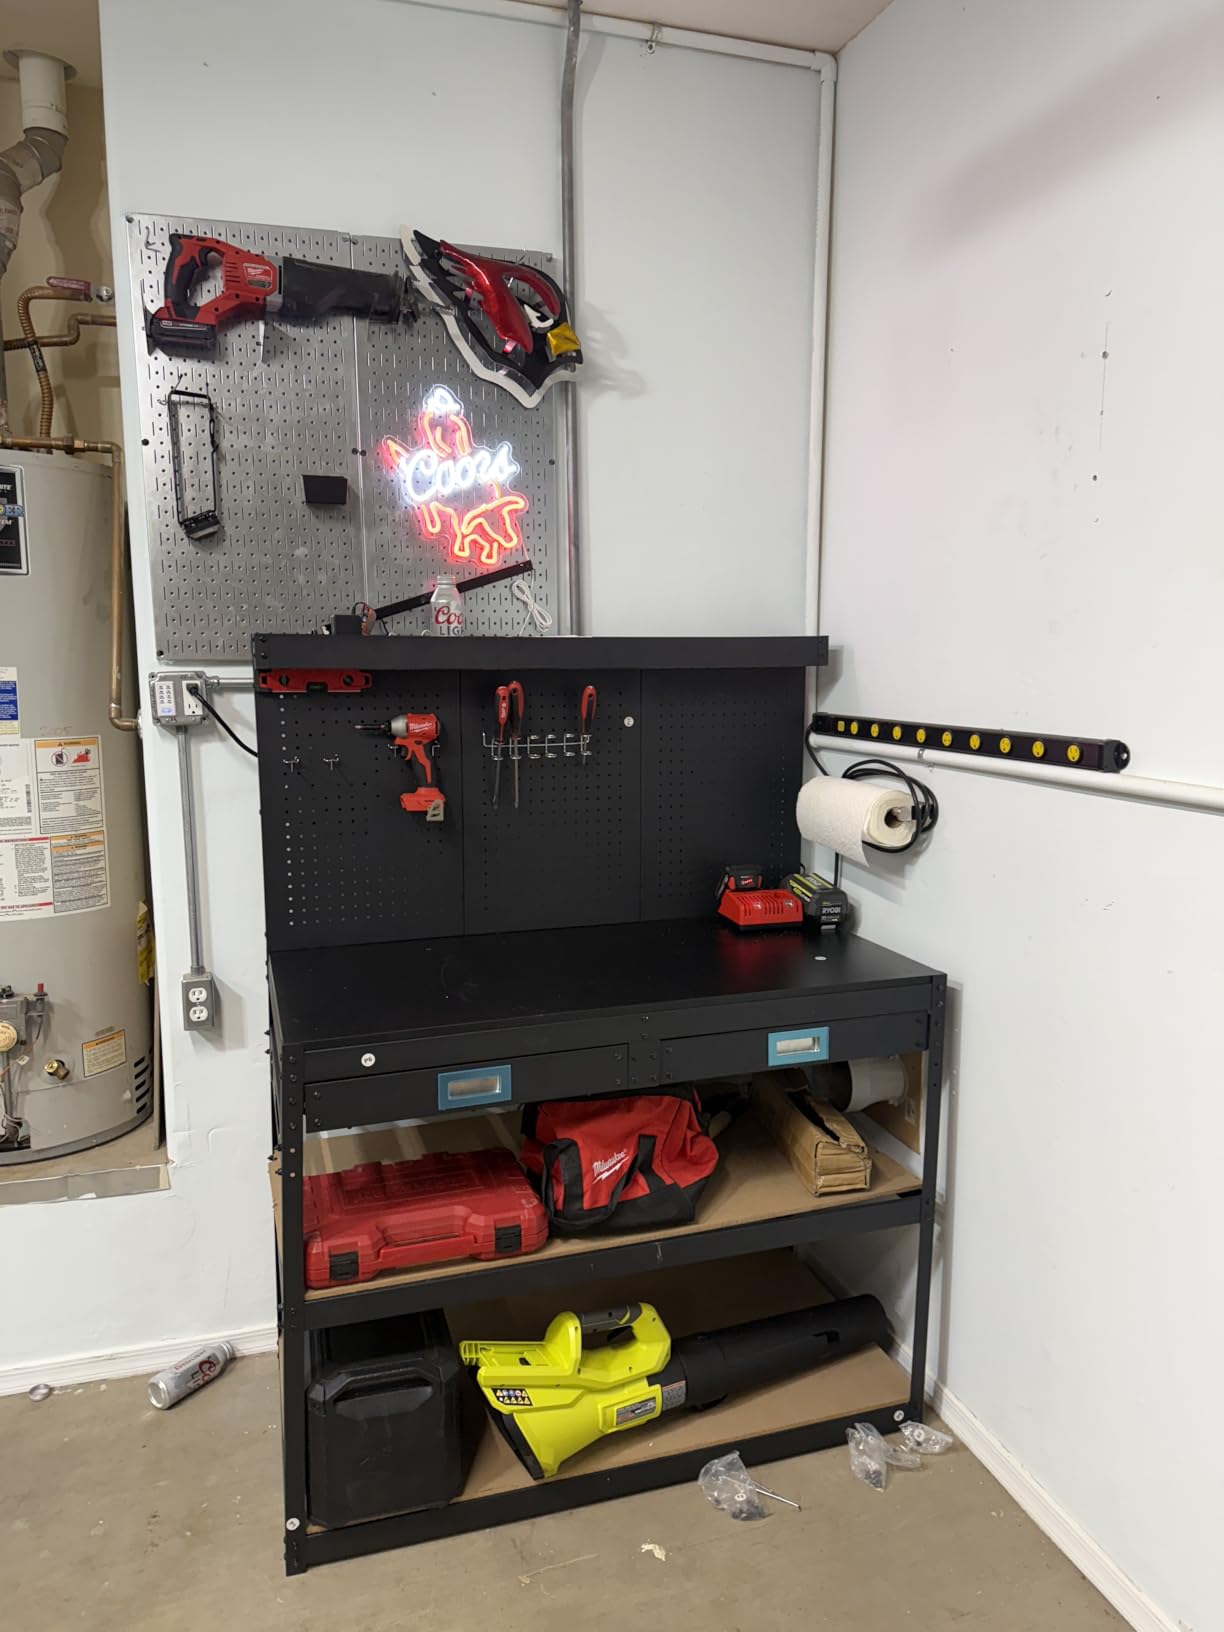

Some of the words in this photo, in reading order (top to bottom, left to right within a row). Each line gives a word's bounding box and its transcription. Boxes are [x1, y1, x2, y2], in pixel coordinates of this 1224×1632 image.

[399, 441, 518, 501] Coors
[821, 906, 841, 914] RYOBI
[592, 1151, 626, 1178] Milwaukee
